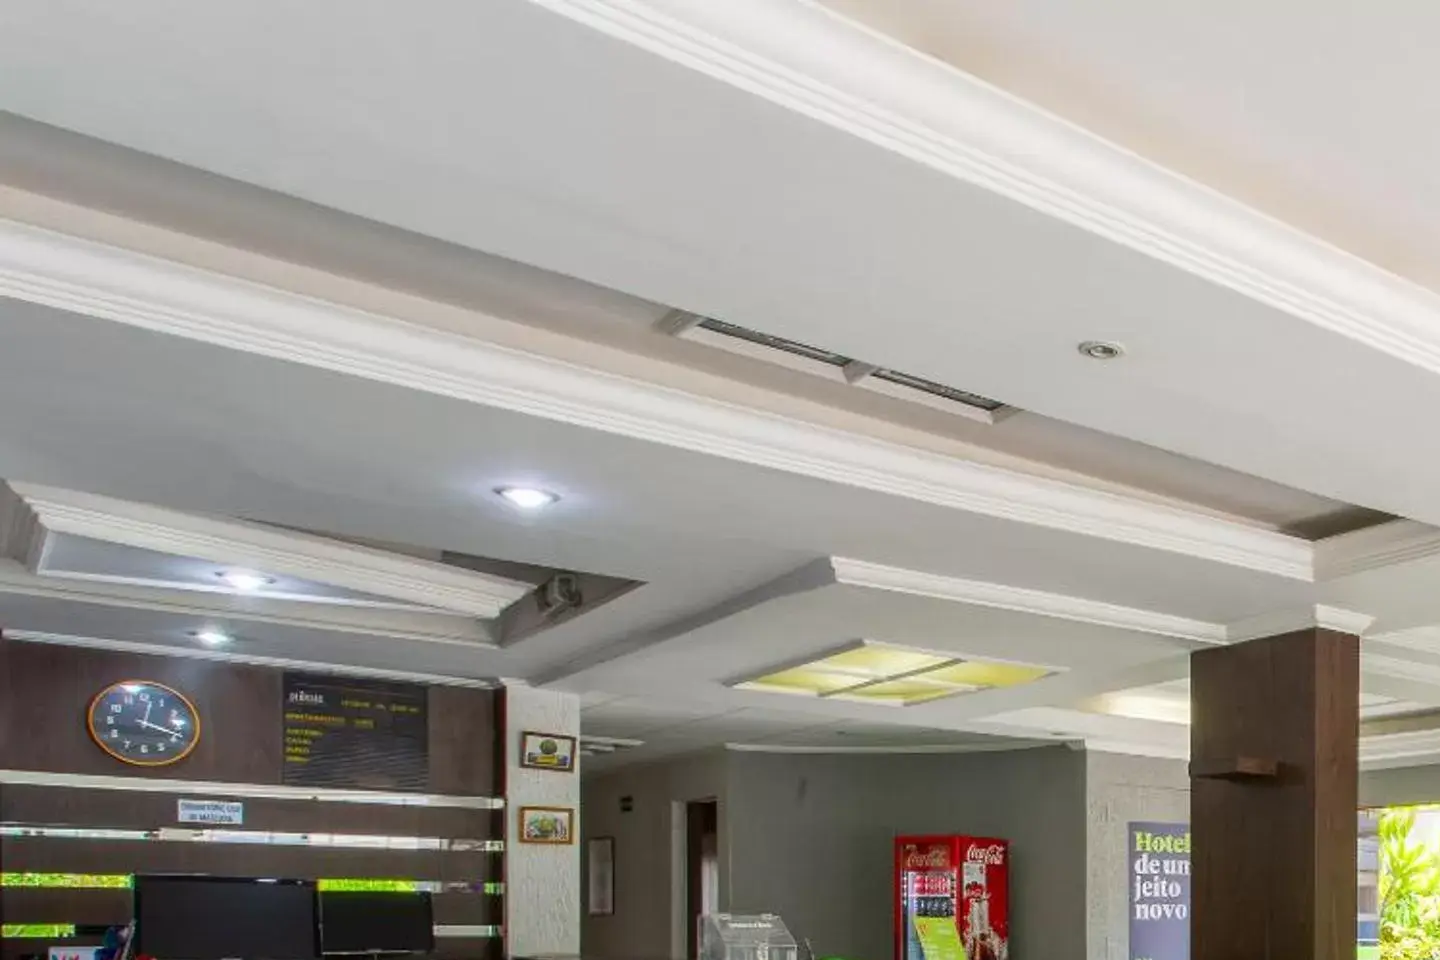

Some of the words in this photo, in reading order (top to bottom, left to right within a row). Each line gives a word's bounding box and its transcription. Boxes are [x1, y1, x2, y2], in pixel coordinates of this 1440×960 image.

[1135, 831, 1191, 853] Hotel
[1134, 853, 1161, 875] de
[1134, 875, 1182, 902] jeito
[1135, 903, 1187, 920] novo
